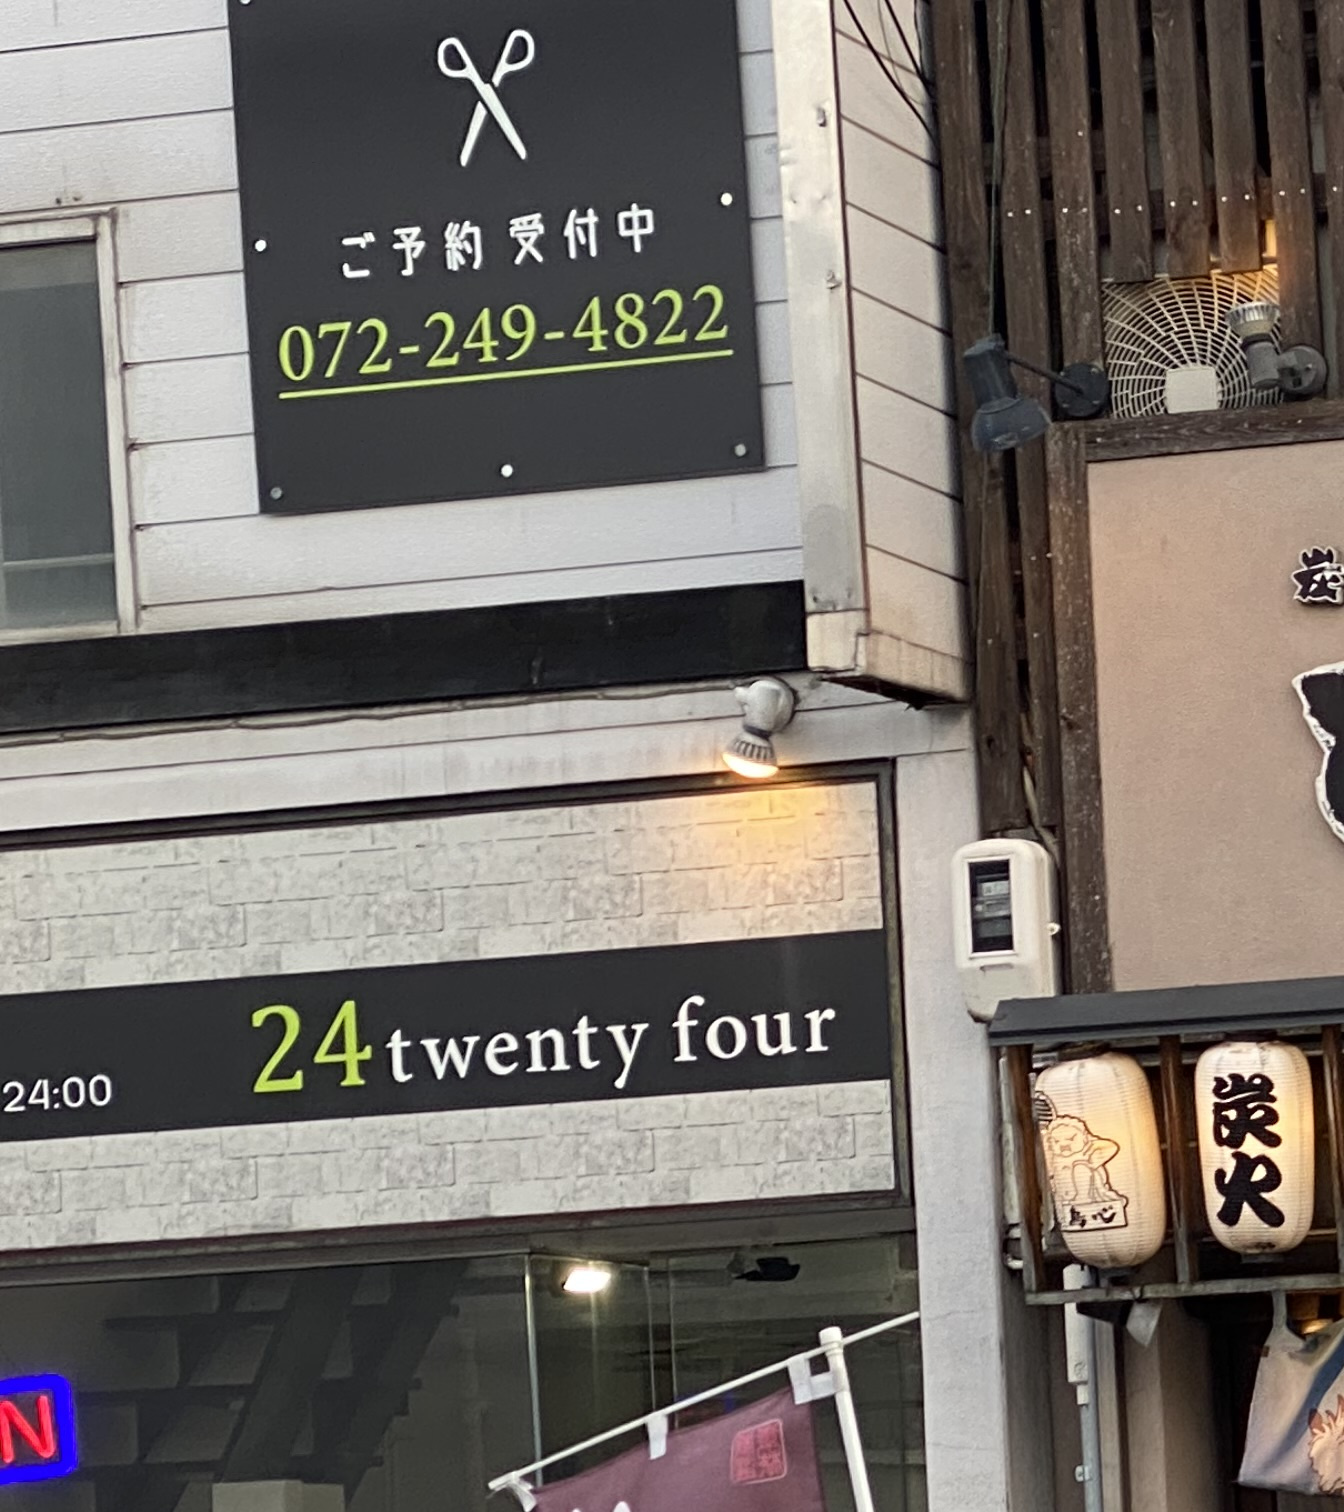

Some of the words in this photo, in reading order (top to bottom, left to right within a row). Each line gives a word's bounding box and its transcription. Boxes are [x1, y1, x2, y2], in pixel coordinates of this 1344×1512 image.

[341, 203, 656, 280] ご予約受付中
[278, 284, 730, 383] 072-249-4822
[2, 1074, 113, 1113] 24:00
[251, 1000, 372, 1096] 24
[386, 1012, 648, 1089] twenty
[672, 996, 837, 1066] four
[1211, 1073, 1286, 1228] 炭火
